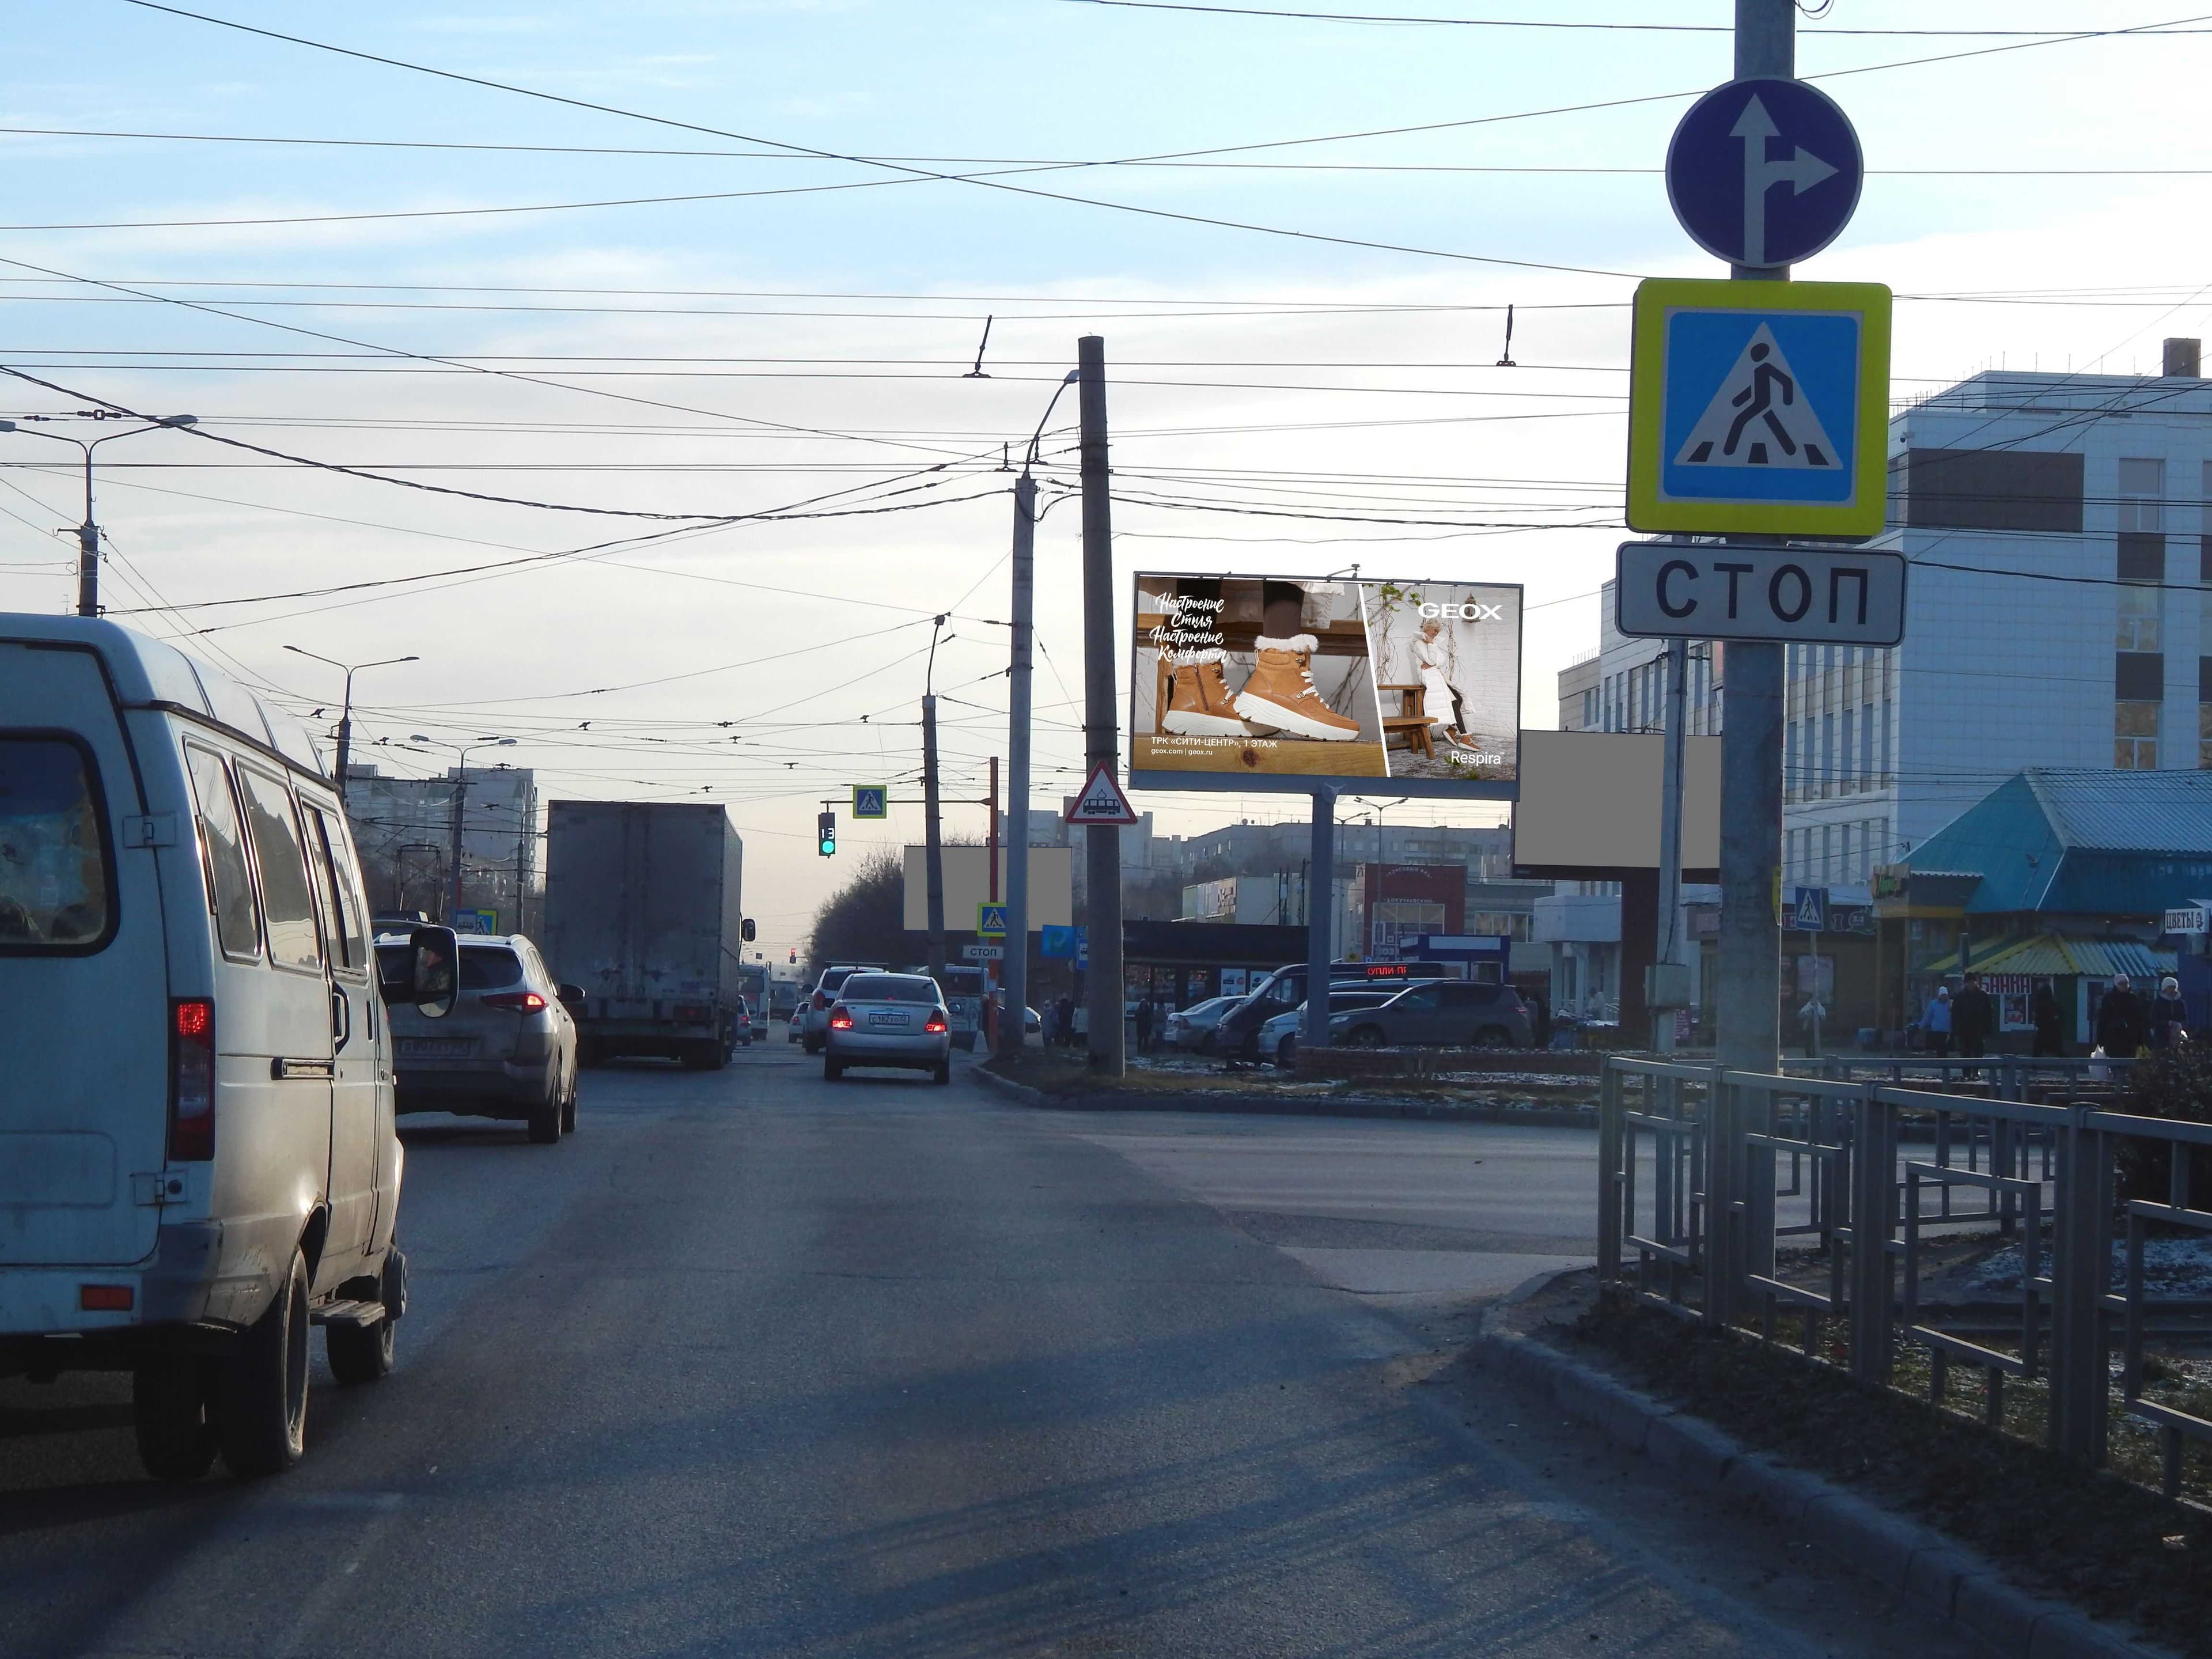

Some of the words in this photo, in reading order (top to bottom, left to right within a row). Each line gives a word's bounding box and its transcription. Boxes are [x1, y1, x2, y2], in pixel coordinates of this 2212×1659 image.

[1656, 560, 1868, 624] СТОП
[1155, 592, 1225, 613] Настроение
[1418, 602, 1503, 620] GEOX
[1171, 611, 1213, 629] Стиля
[1149, 625, 1224, 647] Настроение
[1158, 644, 1228, 664] Комфорта
[1152, 737, 1168, 745] ТРК
[1251, 740, 1278, 748] ЭТАЖ
[821, 827, 835, 839] 13
[2166, 912, 2194, 931] ЦВЕТЫ
[970, 948, 997, 956] СТОП
